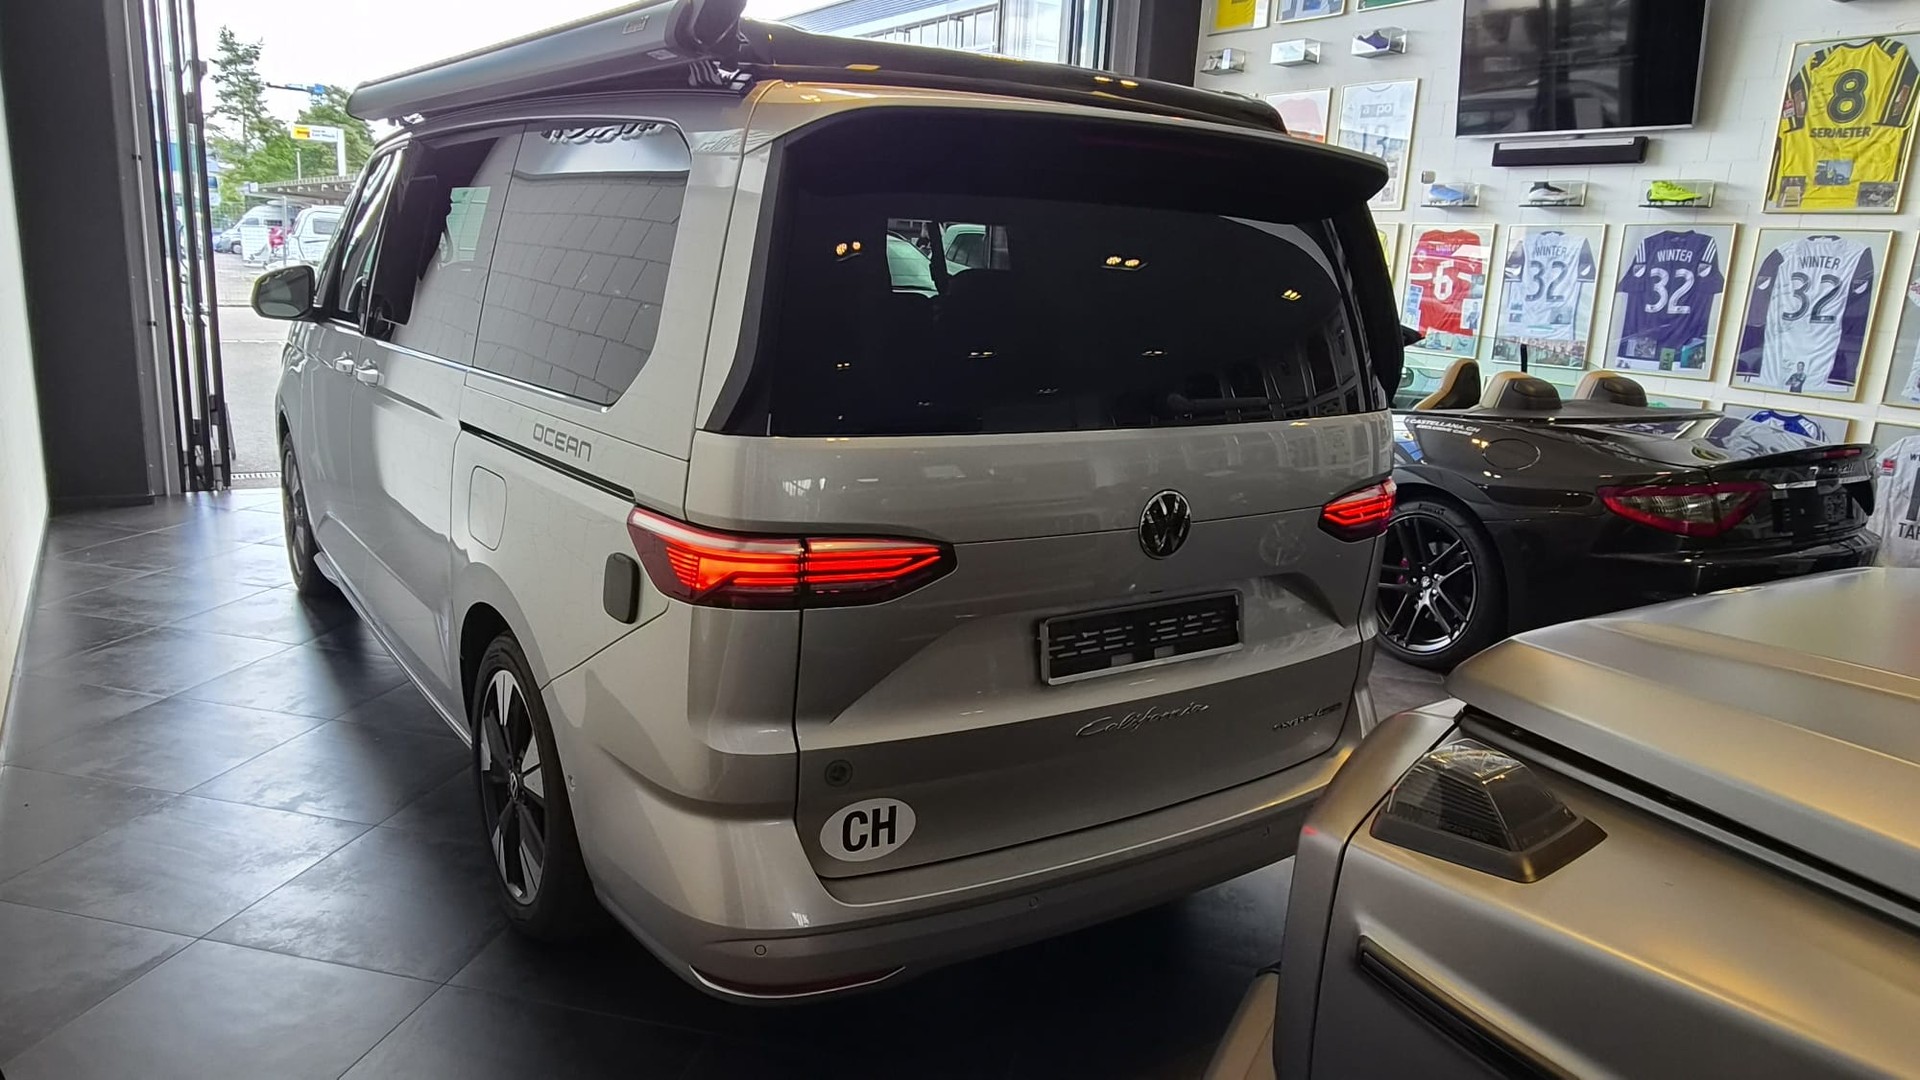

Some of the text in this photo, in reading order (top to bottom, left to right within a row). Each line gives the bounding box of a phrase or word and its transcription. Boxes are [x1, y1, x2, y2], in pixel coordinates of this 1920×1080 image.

[1827, 69, 1868, 123] 8
[1810, 127, 1871, 138] SERMETER
[1535, 245, 1567, 256] WINTER
[1657, 249, 1693, 262] WINTER
[1799, 255, 1841, 269] WINTER
[1433, 259, 1454, 301] 6
[1525, 260, 1568, 301] 32
[1644, 267, 1695, 314] 32
[1782, 271, 1842, 324] 32
[533, 422, 592, 462] OCEAN
[842, 805, 897, 852] CH
